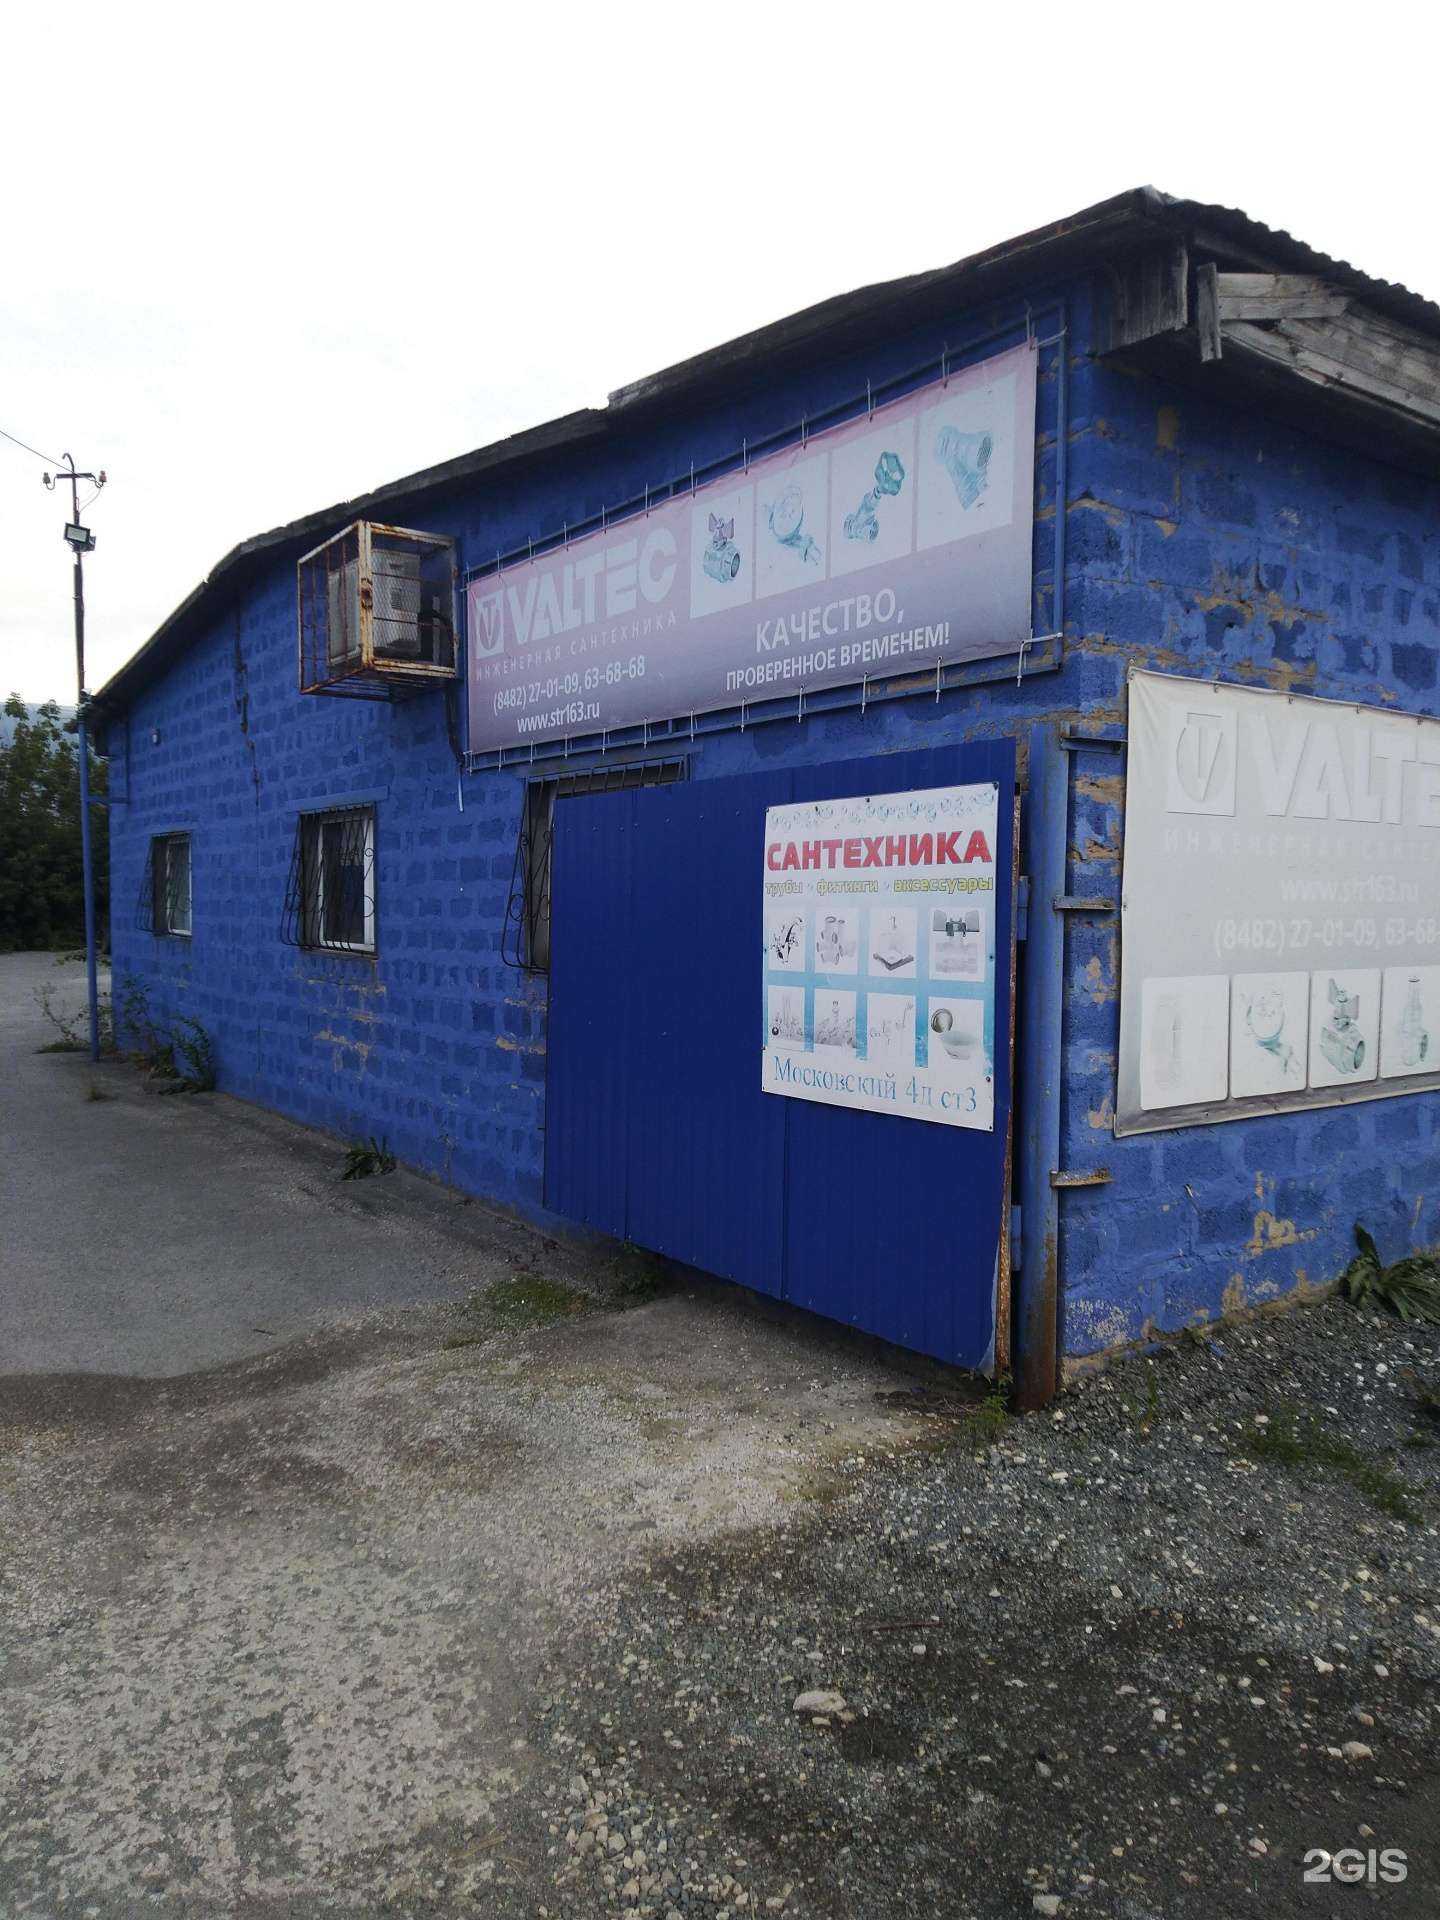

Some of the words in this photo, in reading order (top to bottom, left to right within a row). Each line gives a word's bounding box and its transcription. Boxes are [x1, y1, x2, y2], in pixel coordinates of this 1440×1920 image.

[506, 527, 678, 646] VALTEC
[476, 645, 561, 681] ИНЖЕНЕРНАЯ
[570, 610, 677, 656] САНТЕХНИКА
[756, 588, 904, 653] КАЧЕСТВО,
[726, 647, 836, 691] ПРОВЕРЕННОЕ
[840, 622, 950, 667] ВРЕМЕНЕМ!
[493, 687, 527, 715] (8482)
[528, 672, 582, 704] 27-01-09,
[584, 655, 646, 689] 63-68-68
[517, 701, 600, 733] www.str163.ru
[767, 830, 993, 871] САНТЕХНИКА
[765, 880, 803, 897] трубы
[816, 879, 879, 896] фитинги
[893, 877, 994, 894] аксессуары
[1214, 917, 1286, 957] (8482)
[1288, 917, 1381, 950] 27-01-09,
[774, 1055, 897, 1100] Московский
